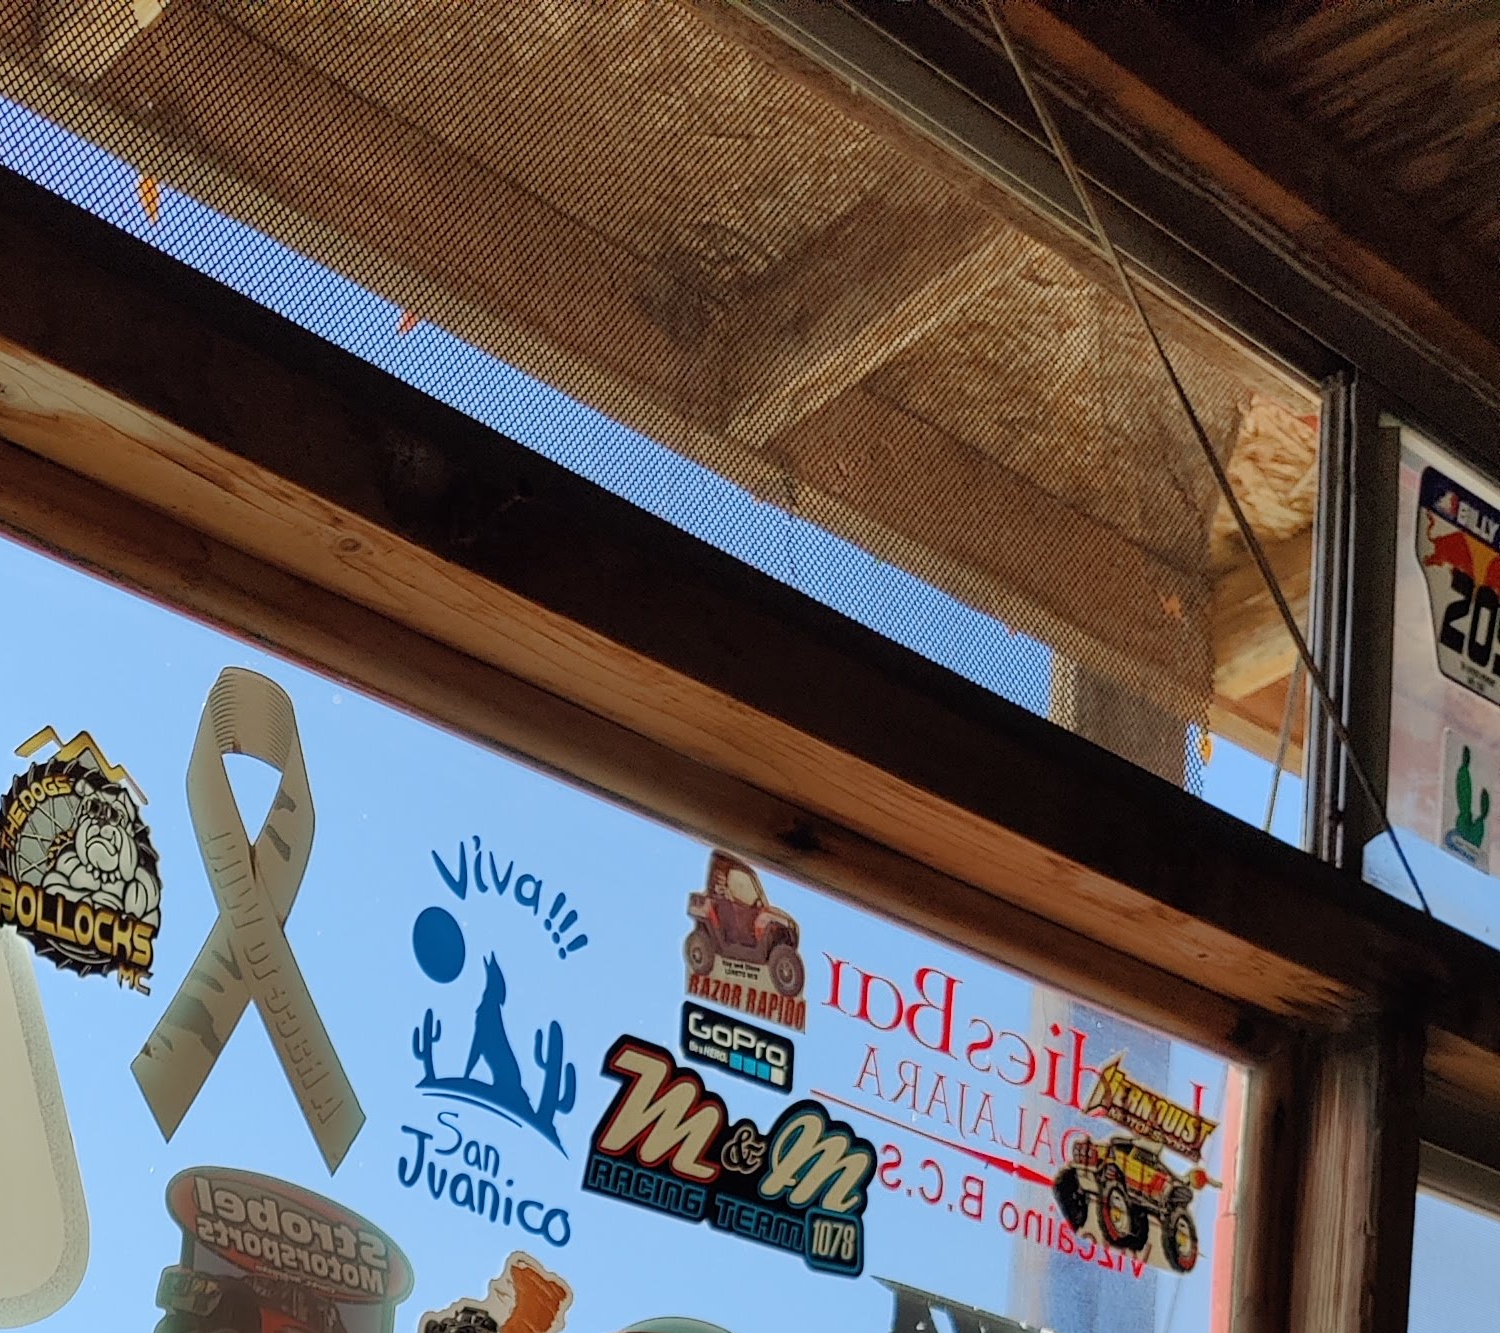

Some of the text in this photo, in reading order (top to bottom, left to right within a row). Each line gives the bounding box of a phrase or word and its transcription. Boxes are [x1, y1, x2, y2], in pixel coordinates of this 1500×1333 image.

[689, 973, 807, 1033] RAZOR RAPIDO
[688, 1010, 788, 1068] GoPro
[435, 1111, 500, 1179] San
[589, 1157, 806, 1251] RACING TEAM
[812, 1216, 857, 1261] 1078
